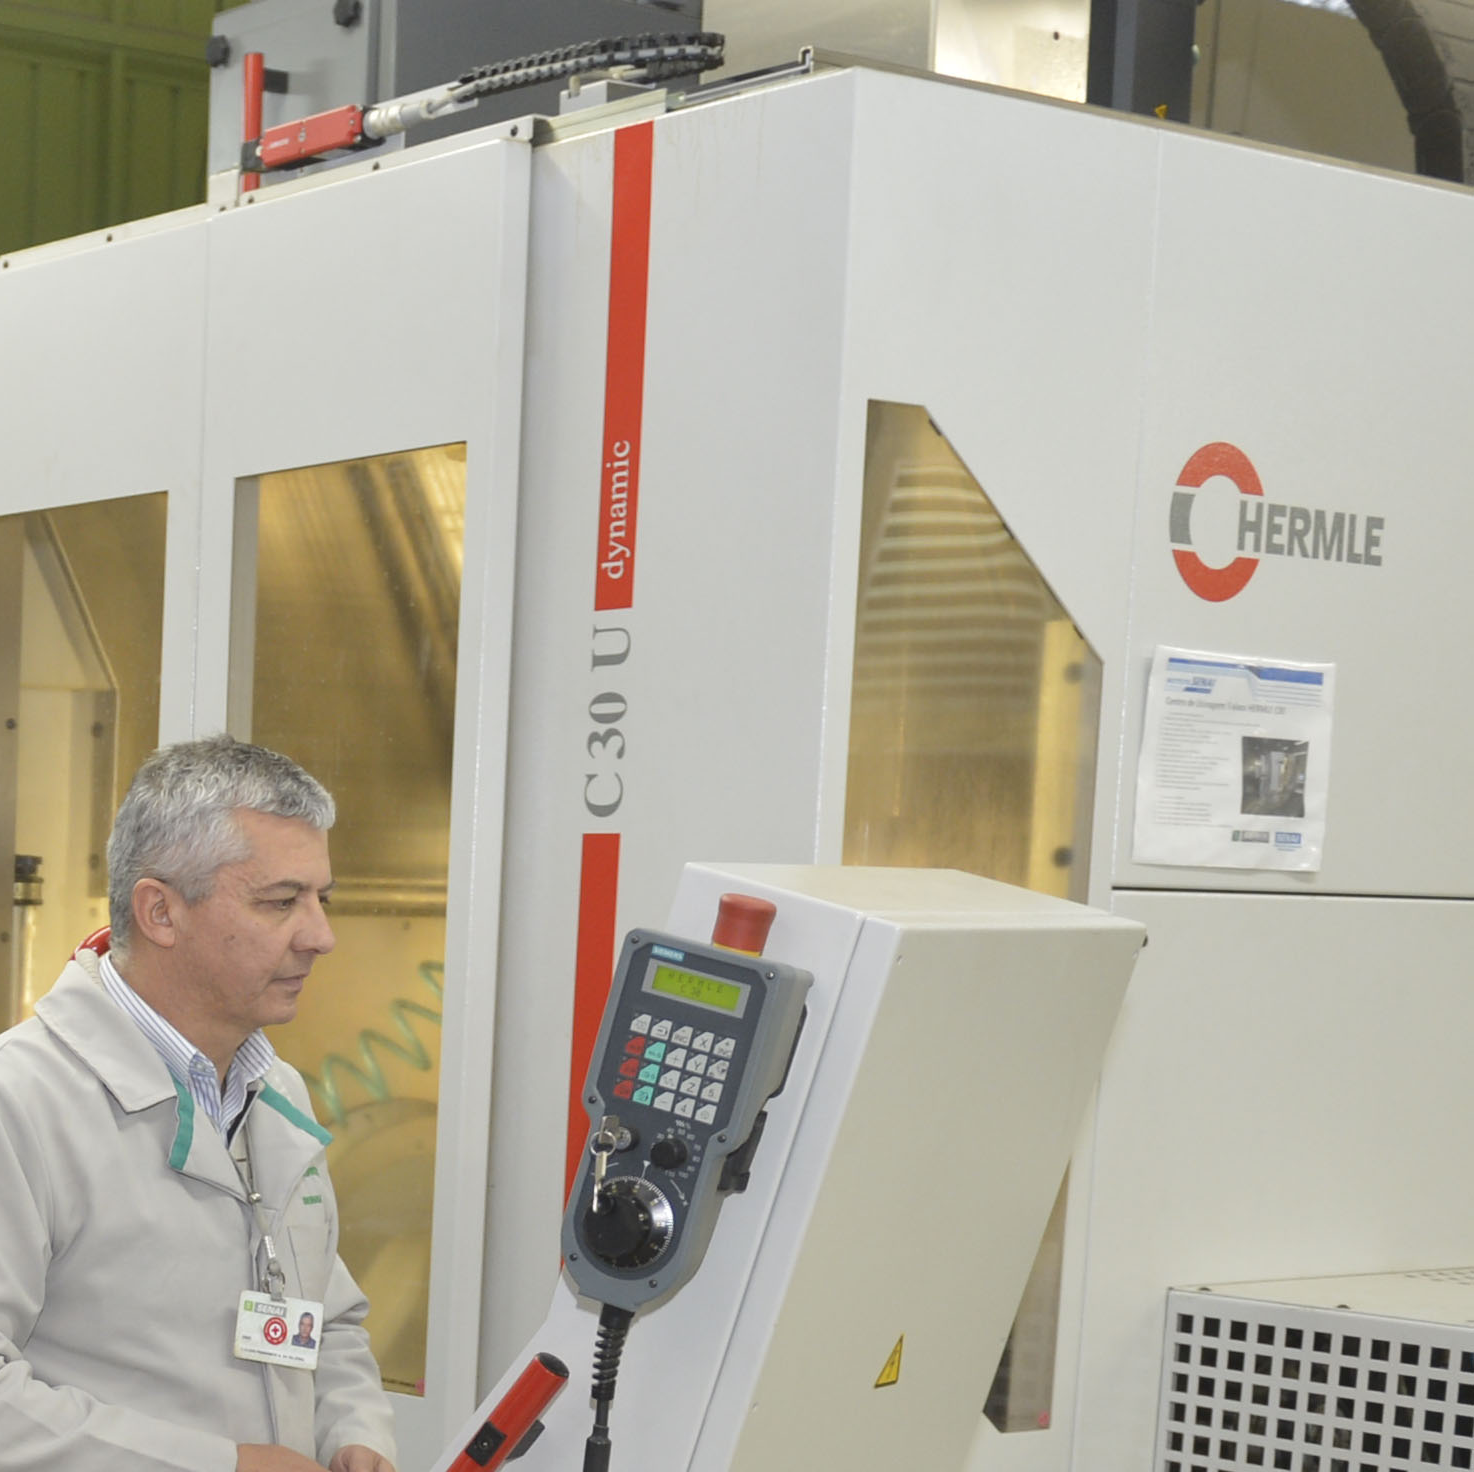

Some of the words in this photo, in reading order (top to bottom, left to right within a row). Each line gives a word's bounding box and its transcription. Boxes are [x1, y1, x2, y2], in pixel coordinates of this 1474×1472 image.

[601, 440, 632, 579] dynamic
[1237, 500, 1386, 566] HERMLE
[590, 624, 632, 672] U
[584, 773, 624, 818] C
